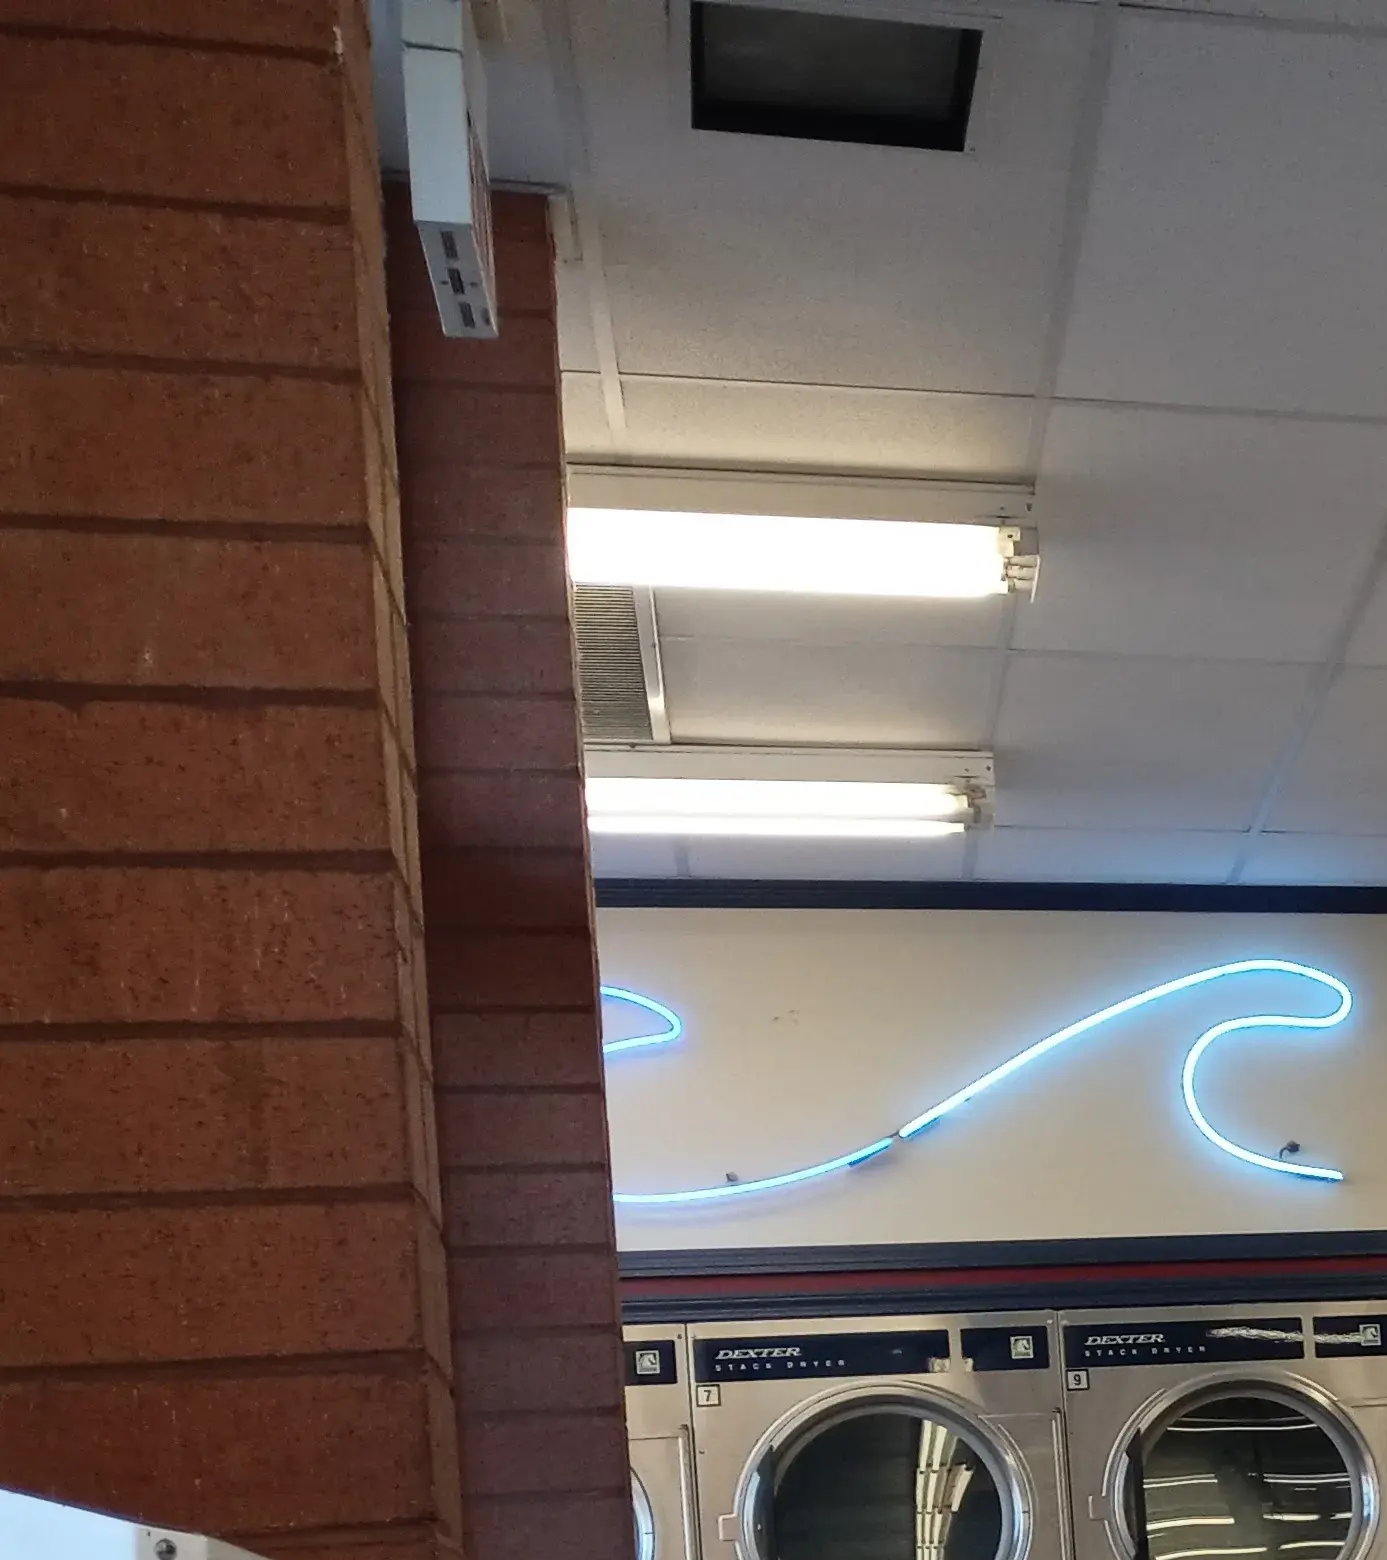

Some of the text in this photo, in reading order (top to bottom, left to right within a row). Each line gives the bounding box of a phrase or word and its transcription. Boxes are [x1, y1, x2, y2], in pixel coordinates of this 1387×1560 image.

[1084, 1333, 1166, 1346] DEXTER
[715, 1347, 802, 1360] DEXTER
[1085, 1346, 1206, 1357] STACK DRYER
[715, 1359, 846, 1372] STACK DRYER
[1073, 1373, 1082, 1386] 9
[703, 1389, 712, 1402] 7
